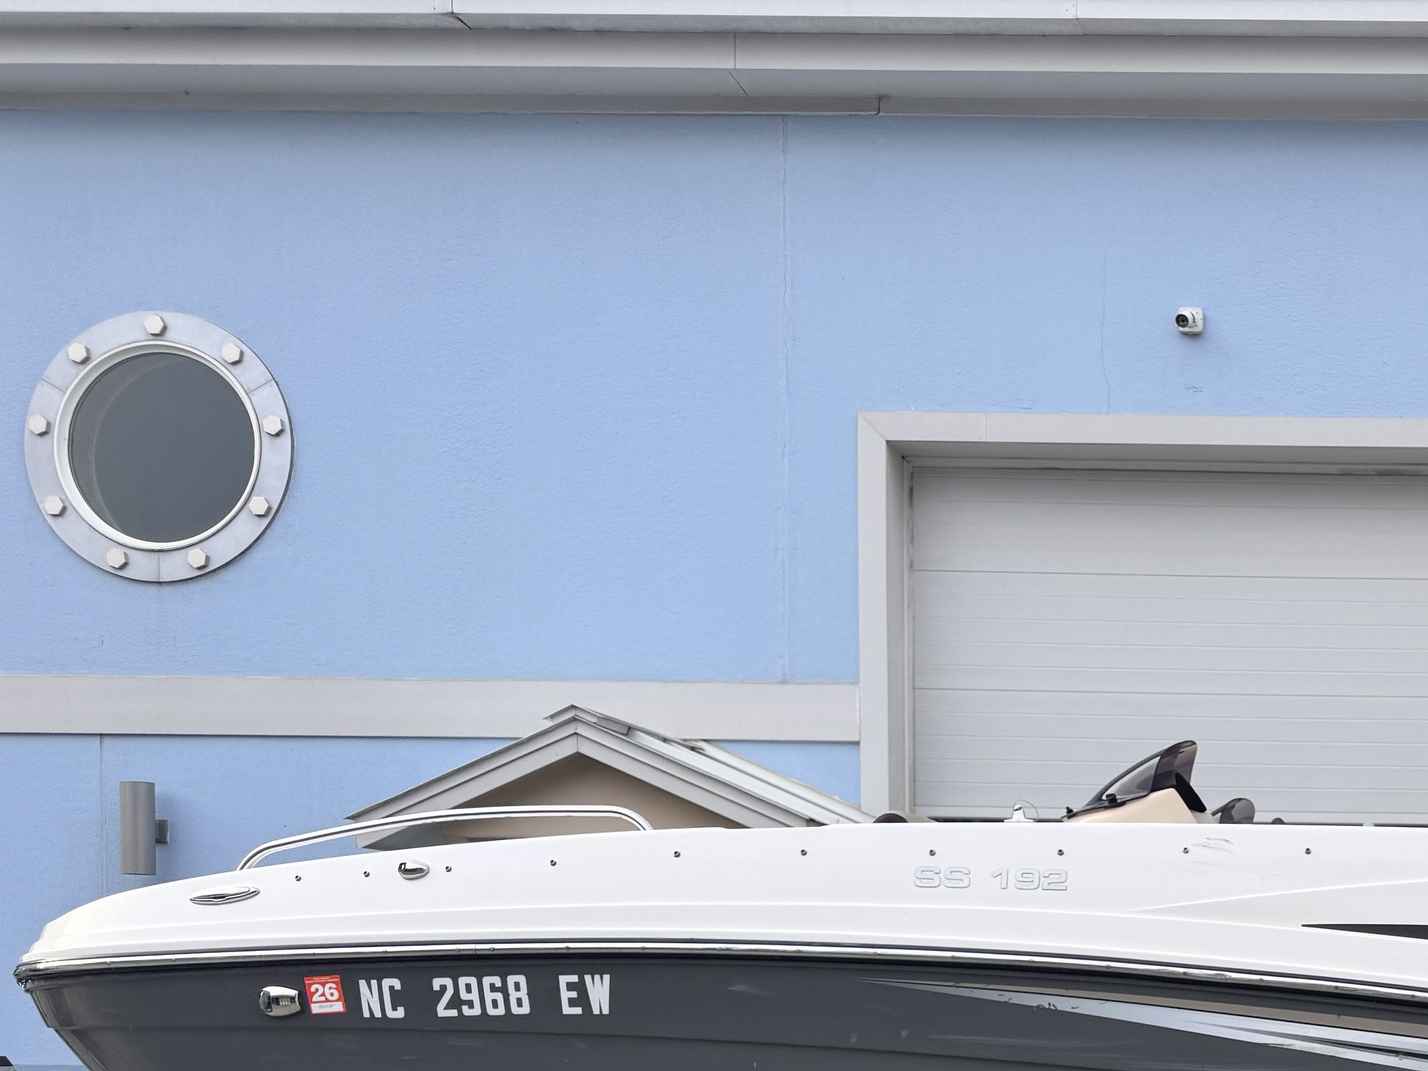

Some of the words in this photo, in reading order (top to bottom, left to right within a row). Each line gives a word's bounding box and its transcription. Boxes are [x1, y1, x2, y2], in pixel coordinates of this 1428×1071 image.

[913, 864, 972, 889] SS
[991, 865, 1069, 892] 192
[310, 982, 340, 1002] 26
[358, 977, 405, 1019] NC
[432, 974, 531, 1017] 2968
[558, 974, 611, 1015] EW
